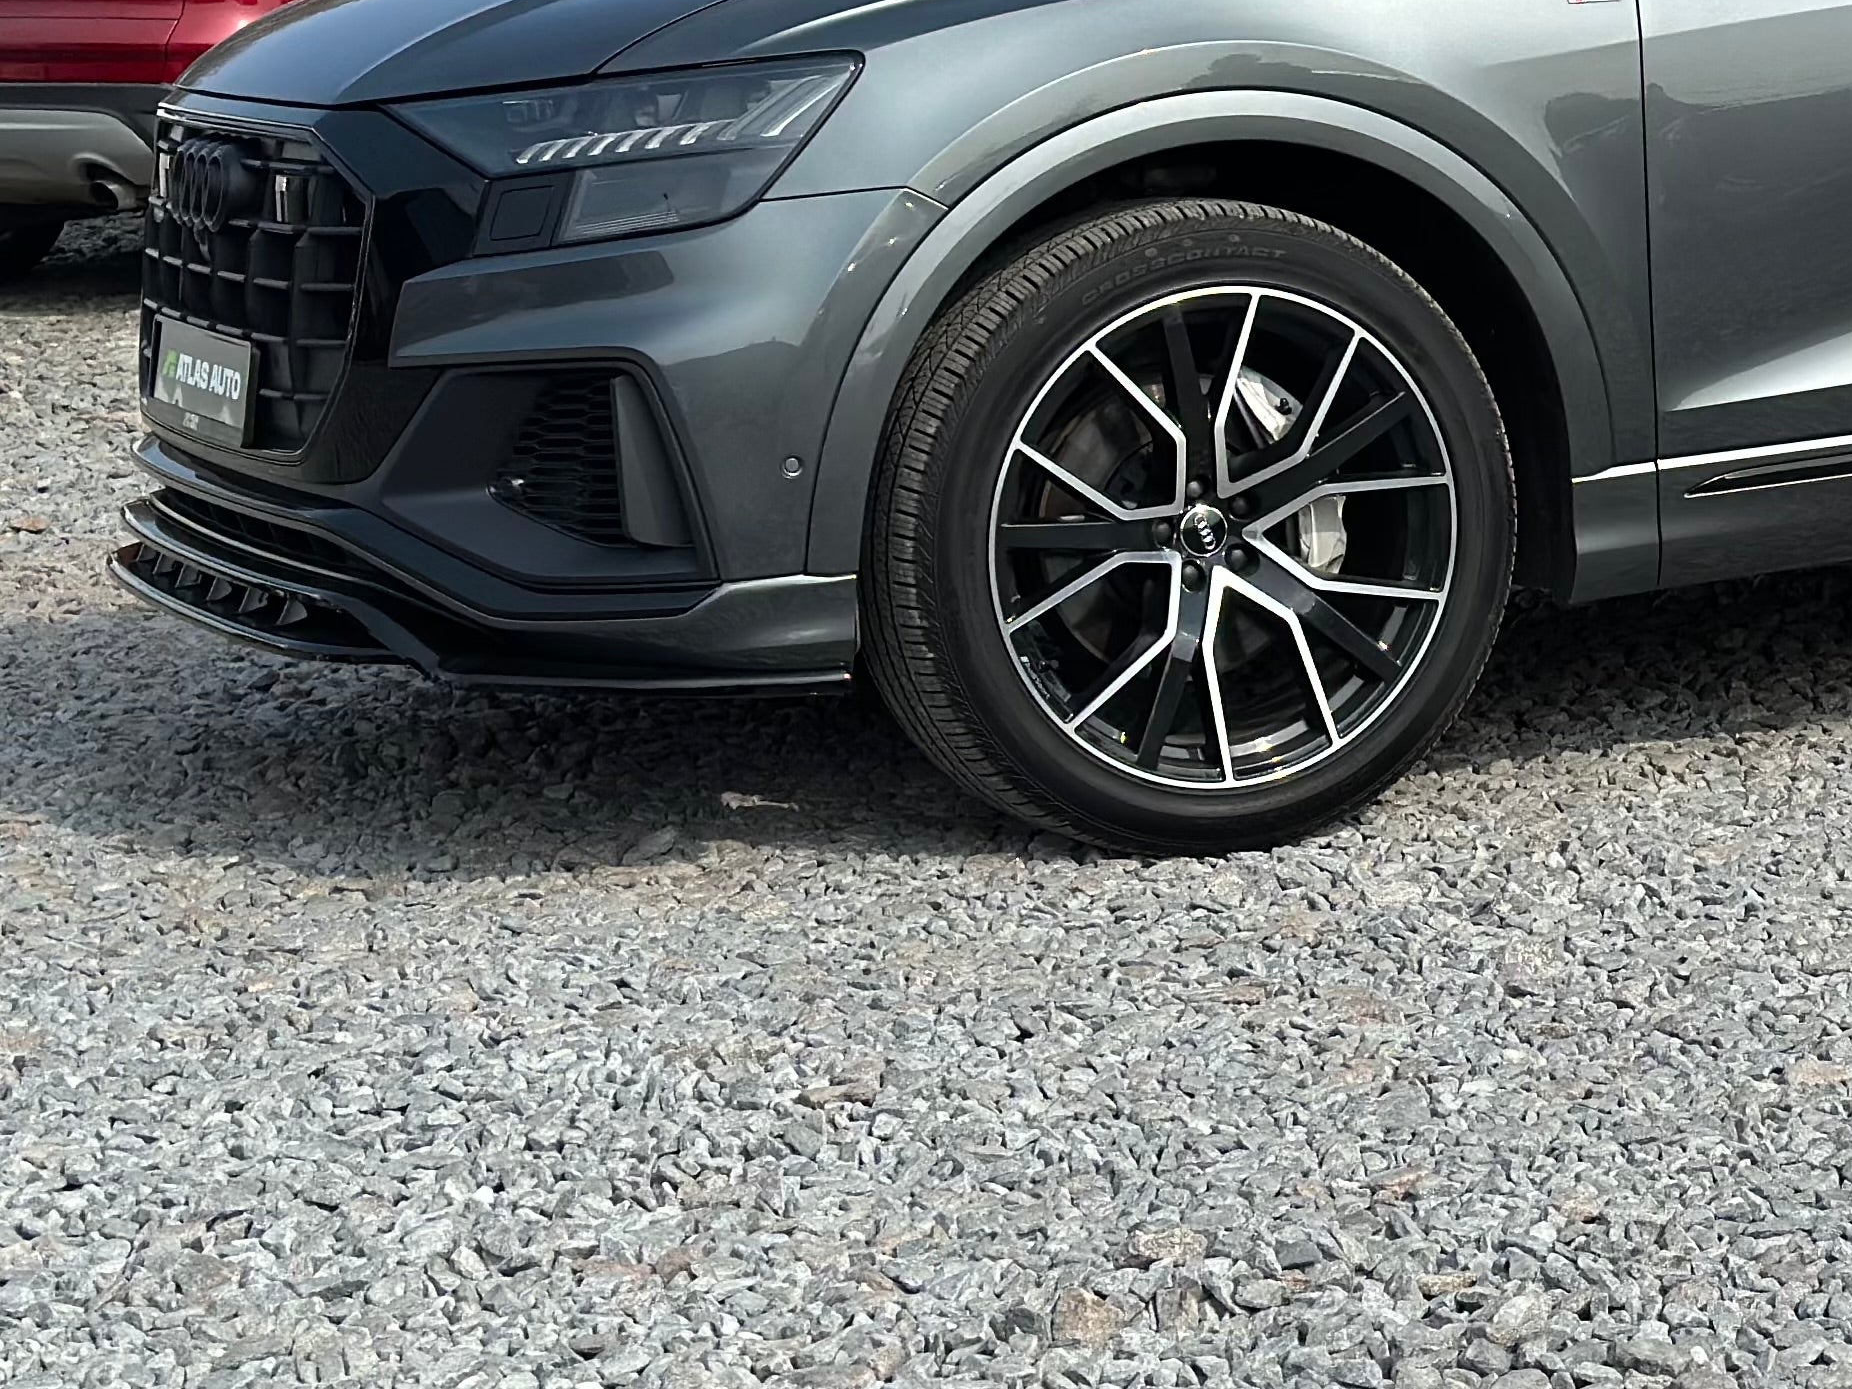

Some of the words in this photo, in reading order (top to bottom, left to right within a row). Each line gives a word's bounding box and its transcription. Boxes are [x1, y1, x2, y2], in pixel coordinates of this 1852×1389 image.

[1081, 244, 1288, 306] CROSSCONTACT
[176, 352, 210, 389] ATLAS
[208, 364, 241, 400] AUTO
